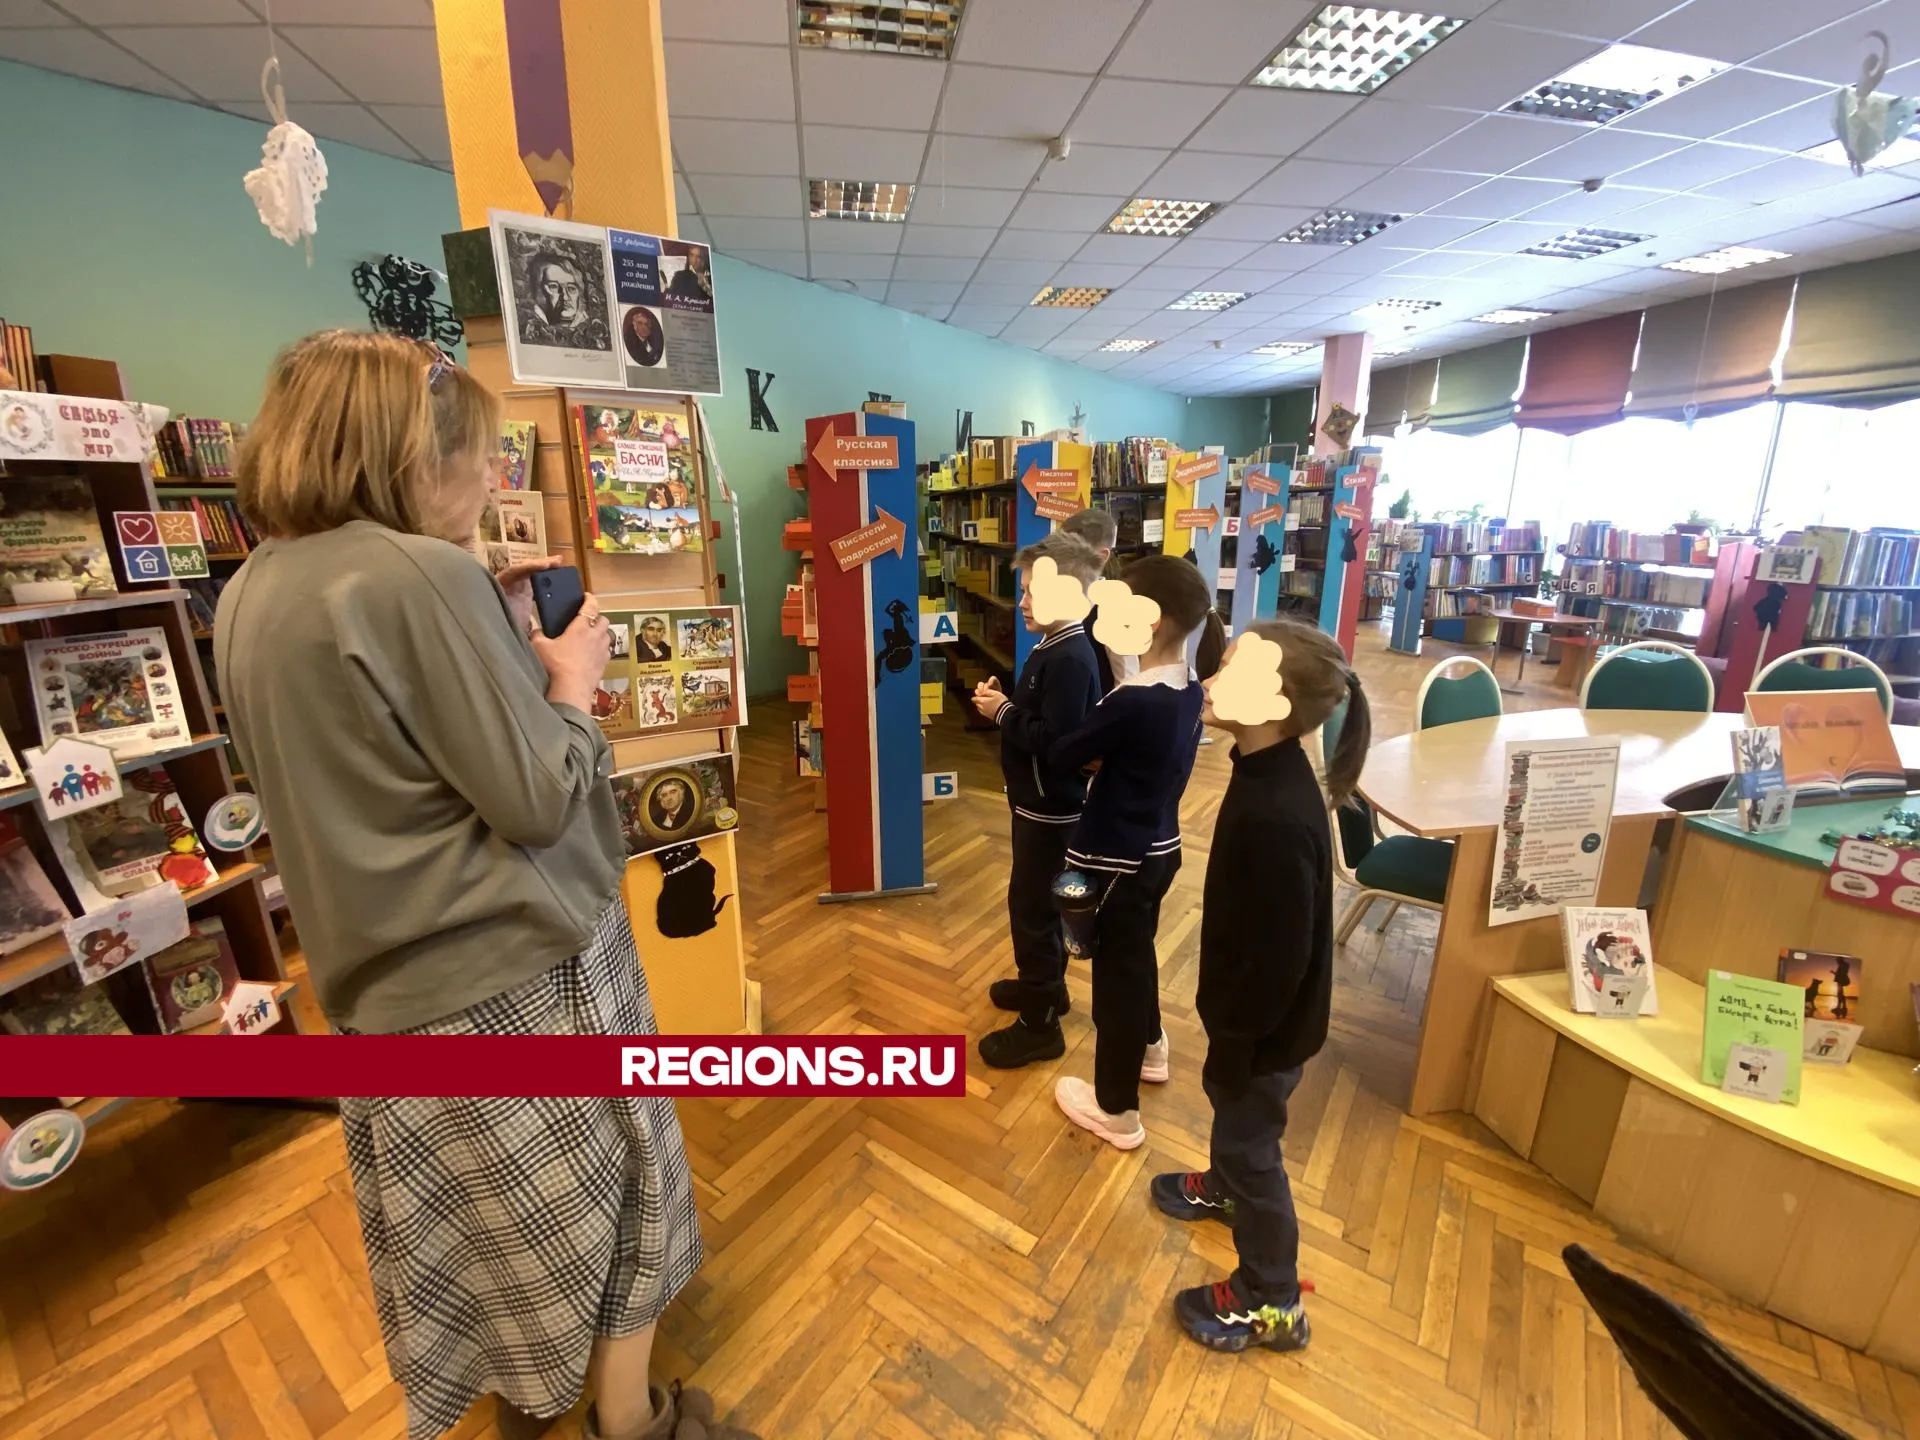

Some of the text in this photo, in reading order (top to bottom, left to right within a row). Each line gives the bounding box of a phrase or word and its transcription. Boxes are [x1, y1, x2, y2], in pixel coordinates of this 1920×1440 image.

[621, 280, 655, 291] рождения
[836, 439, 888, 452] Русская
[620, 451, 664, 468] БАСНИ
[833, 457, 893, 468] классика
[1037, 505, 1074, 518] подростк
[1226, 518, 1239, 533] Б
[838, 523, 888, 550] Писатели
[839, 533, 899, 566] подросткам
[933, 614, 957, 638] А
[933, 775, 954, 796] Б
